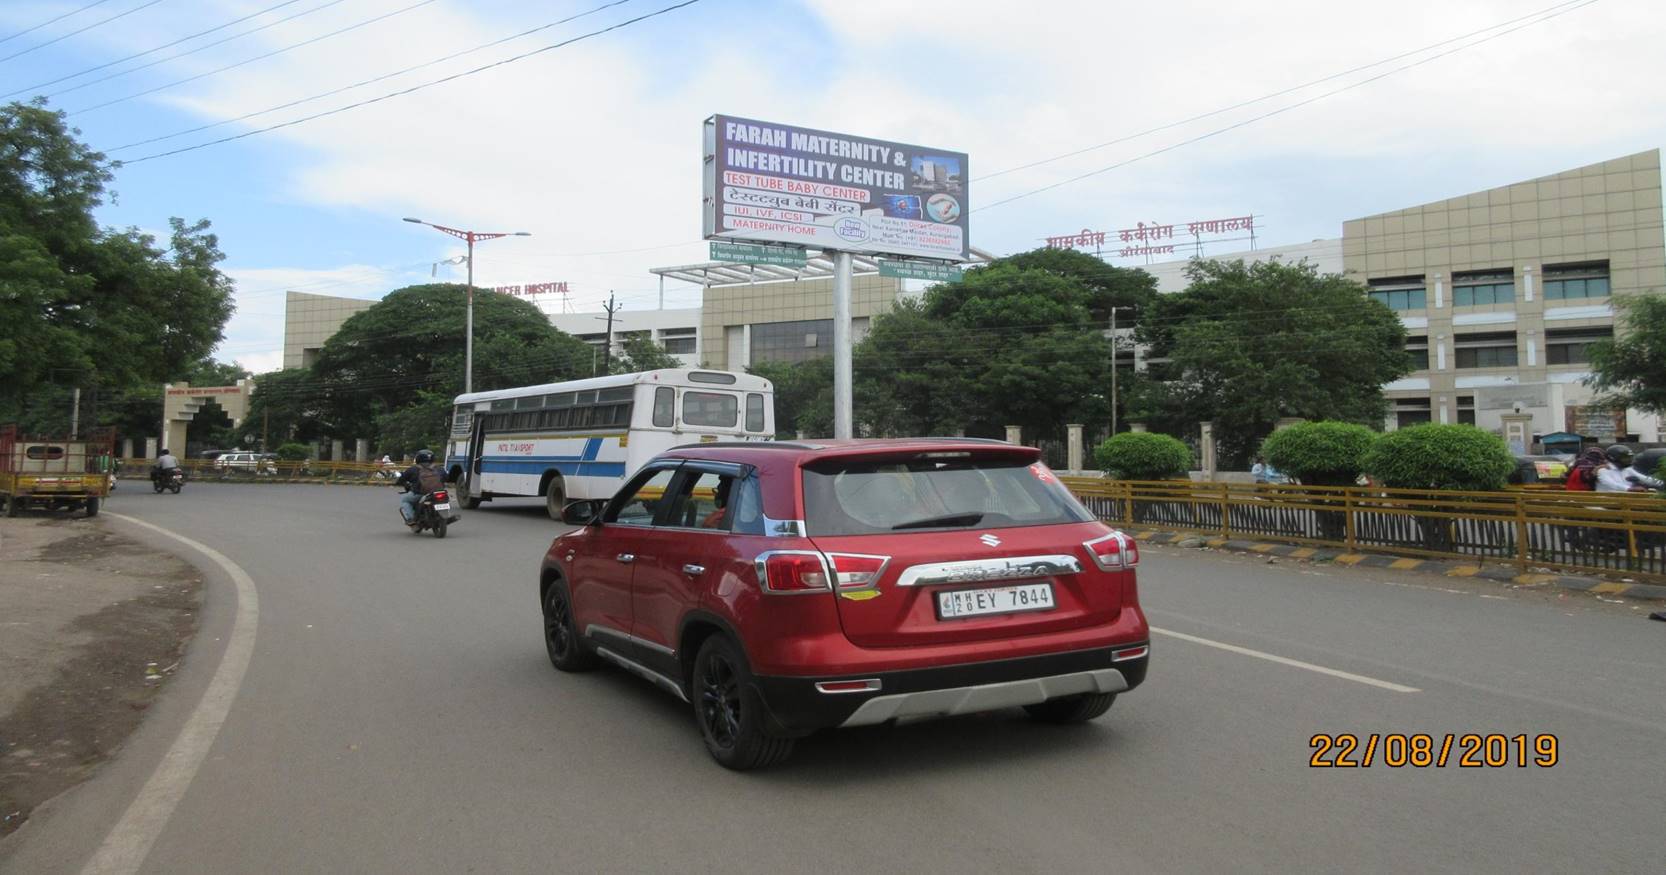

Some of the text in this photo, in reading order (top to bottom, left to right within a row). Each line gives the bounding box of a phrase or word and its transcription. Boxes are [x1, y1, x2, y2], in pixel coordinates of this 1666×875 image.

[726, 122, 907, 167] FARAH MATERNITY &
[727, 147, 905, 190] INFERTILITY CENTER
[726, 172, 866, 201] TEST TUBE BABY CENTER
[780, 211, 803, 222] ICSI
[732, 219, 817, 236] MATERNITY HOME
[524, 281, 569, 296] HOSPITAL
[976, 592, 996, 609] EY
[1009, 588, 1049, 606] 7844
